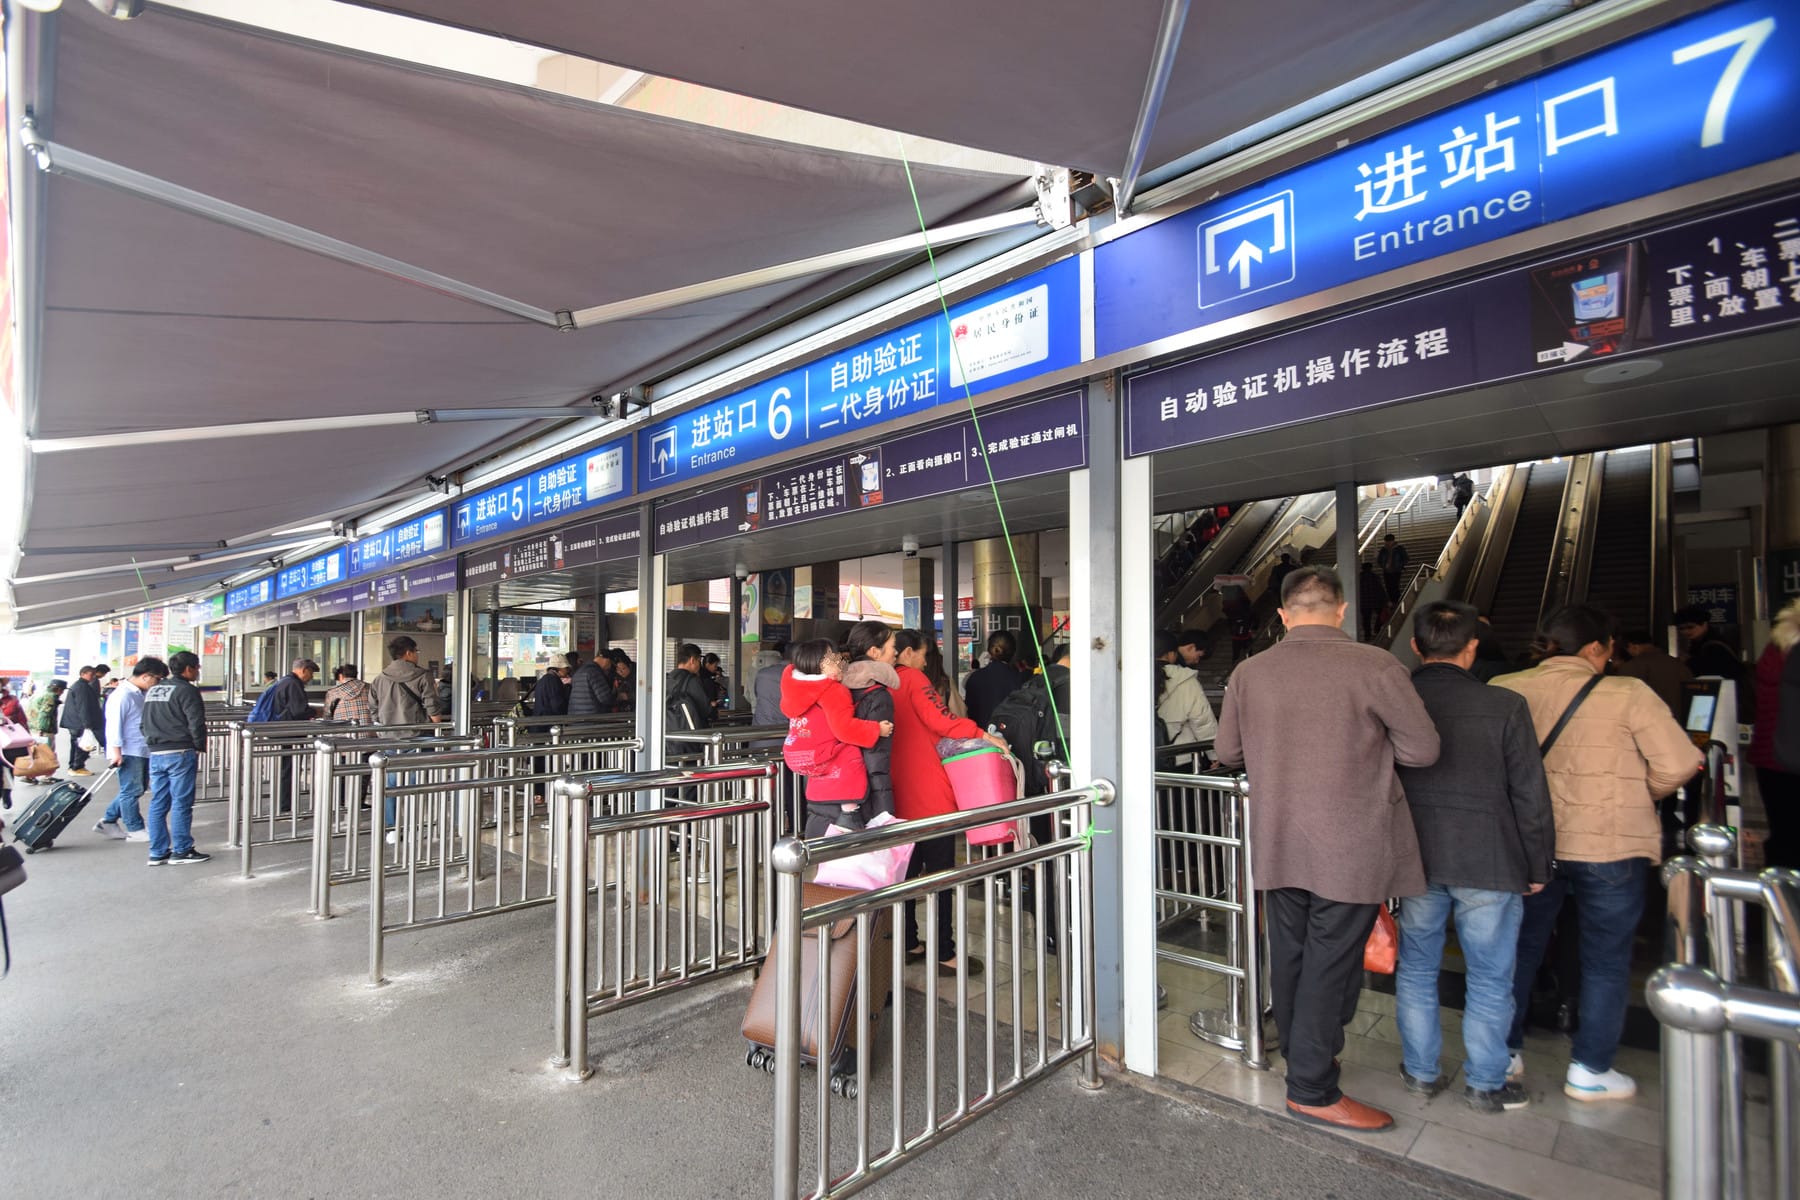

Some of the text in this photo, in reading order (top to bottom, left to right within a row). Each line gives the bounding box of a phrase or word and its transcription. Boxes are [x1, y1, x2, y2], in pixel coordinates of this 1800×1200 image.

[1354, 17, 1776, 222] 进站口 7
[1353, 188, 1533, 262] Entrance
[831, 333, 922, 393] 自助验证
[1160, 327, 1450, 421] 自动验证机操作流程
[819, 368, 936, 429] 二代身份证
[691, 386, 792, 449] 进站口 6
[691, 446, 736, 469] Entrance
[538, 463, 577, 494] 自助验证
[476, 485, 523, 522] 进站口 5
[533, 486, 582, 517] 二代身份证
[476, 521, 498, 535] Entrance
[659, 506, 729, 535] 自动验证机操作流程
[383, 535, 390, 561] 4
[987, 613, 1022, 631] 出口
